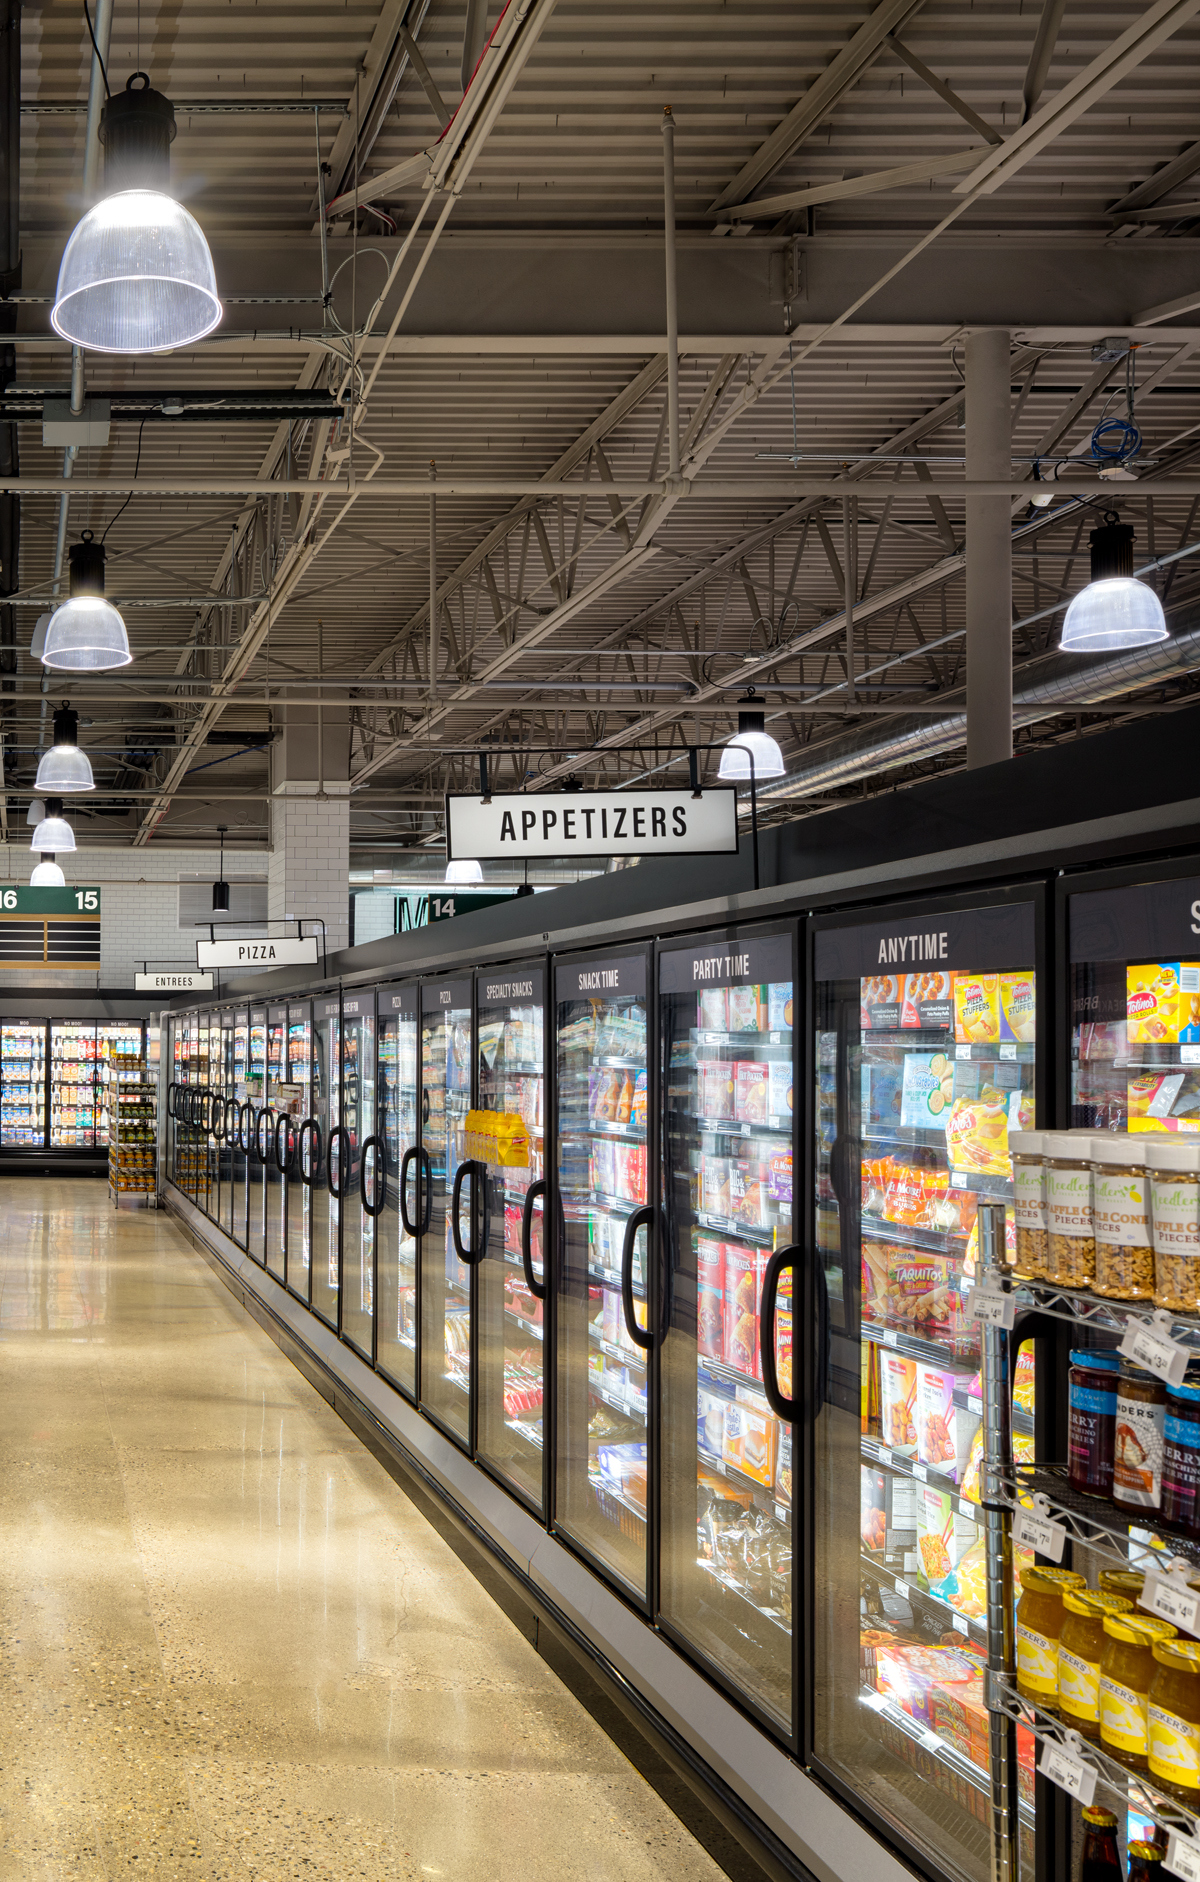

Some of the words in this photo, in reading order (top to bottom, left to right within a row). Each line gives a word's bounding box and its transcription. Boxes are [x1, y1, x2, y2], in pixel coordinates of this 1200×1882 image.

[500, 805, 687, 841] APPETIZERS
[75, 891, 98, 910] 15
[432, 899, 455, 917] 14
[239, 946, 276, 960] PIZZA
[878, 932, 948, 964] ANYTIME
[693, 958, 724, 981] PARTY
[725, 954, 749, 977] TIME
[155, 976, 193, 987] ENTREES
[579, 971, 601, 990] SNACK
[601, 969, 619, 988] TIME
[1161, 971, 1176, 979] NEW!
[440, 990, 451, 1004] PIZZA
[486, 983, 511, 1000] SPECIALTY
[512, 981, 533, 998] SNACKS
[963, 985, 983, 999] Totino's
[1011, 984, 1031, 996] Totino's
[967, 996, 983, 1006] PIZZA
[1014, 995, 1031, 1004] PIZZA
[1128, 996, 1154, 1013] Totino's
[962, 1004, 989, 1017] STUFFERS
[746, 1070, 764, 1081] POCKETS
[730, 1169, 740, 1186] BIG
[740, 1180, 745, 1188] &
[730, 1187, 745, 1198] BOLD
[1055, 1214, 1093, 1226] PIECES
[1110, 1212, 1149, 1225] CONE
[1158, 1231, 1200, 1244] PIECES
[894, 1268, 943, 1282] TAQUITOS
[745, 1366, 753, 1376] 12
[922, 1622, 931, 1632] PAD
[923, 1614, 944, 1630] CHICKEN
